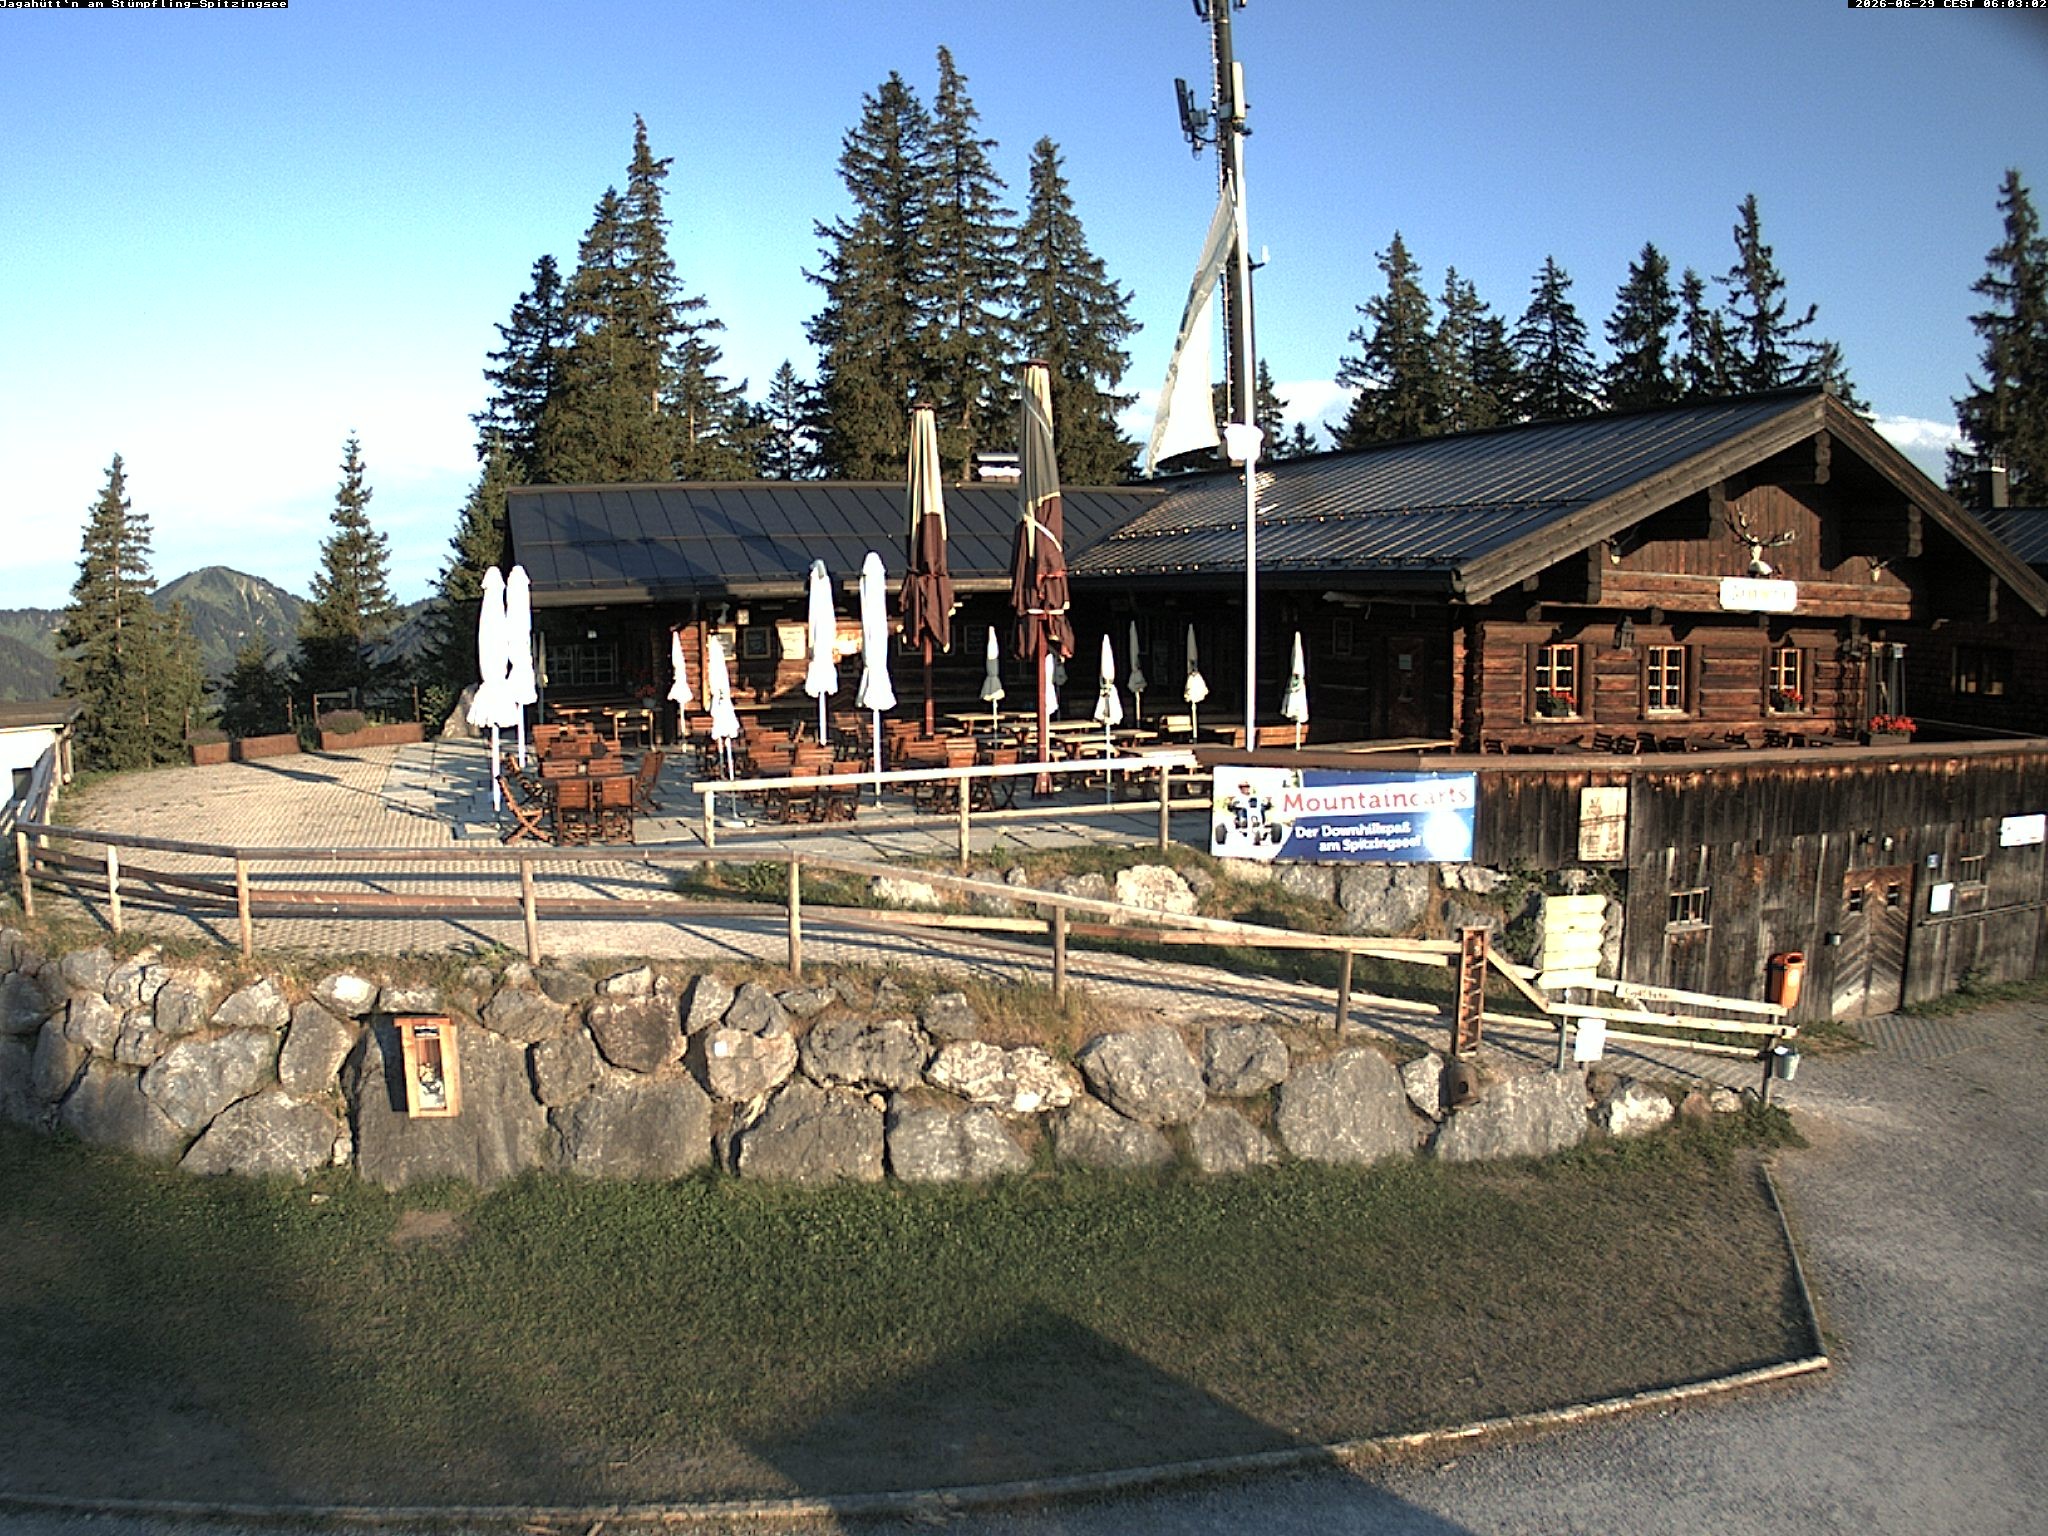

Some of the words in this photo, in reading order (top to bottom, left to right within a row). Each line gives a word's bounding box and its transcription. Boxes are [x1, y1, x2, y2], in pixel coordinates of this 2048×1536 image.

[1283, 787, 1468, 813] Mountaincarts
[1295, 826, 1319, 838] Der
[1319, 840, 1341, 851] am
